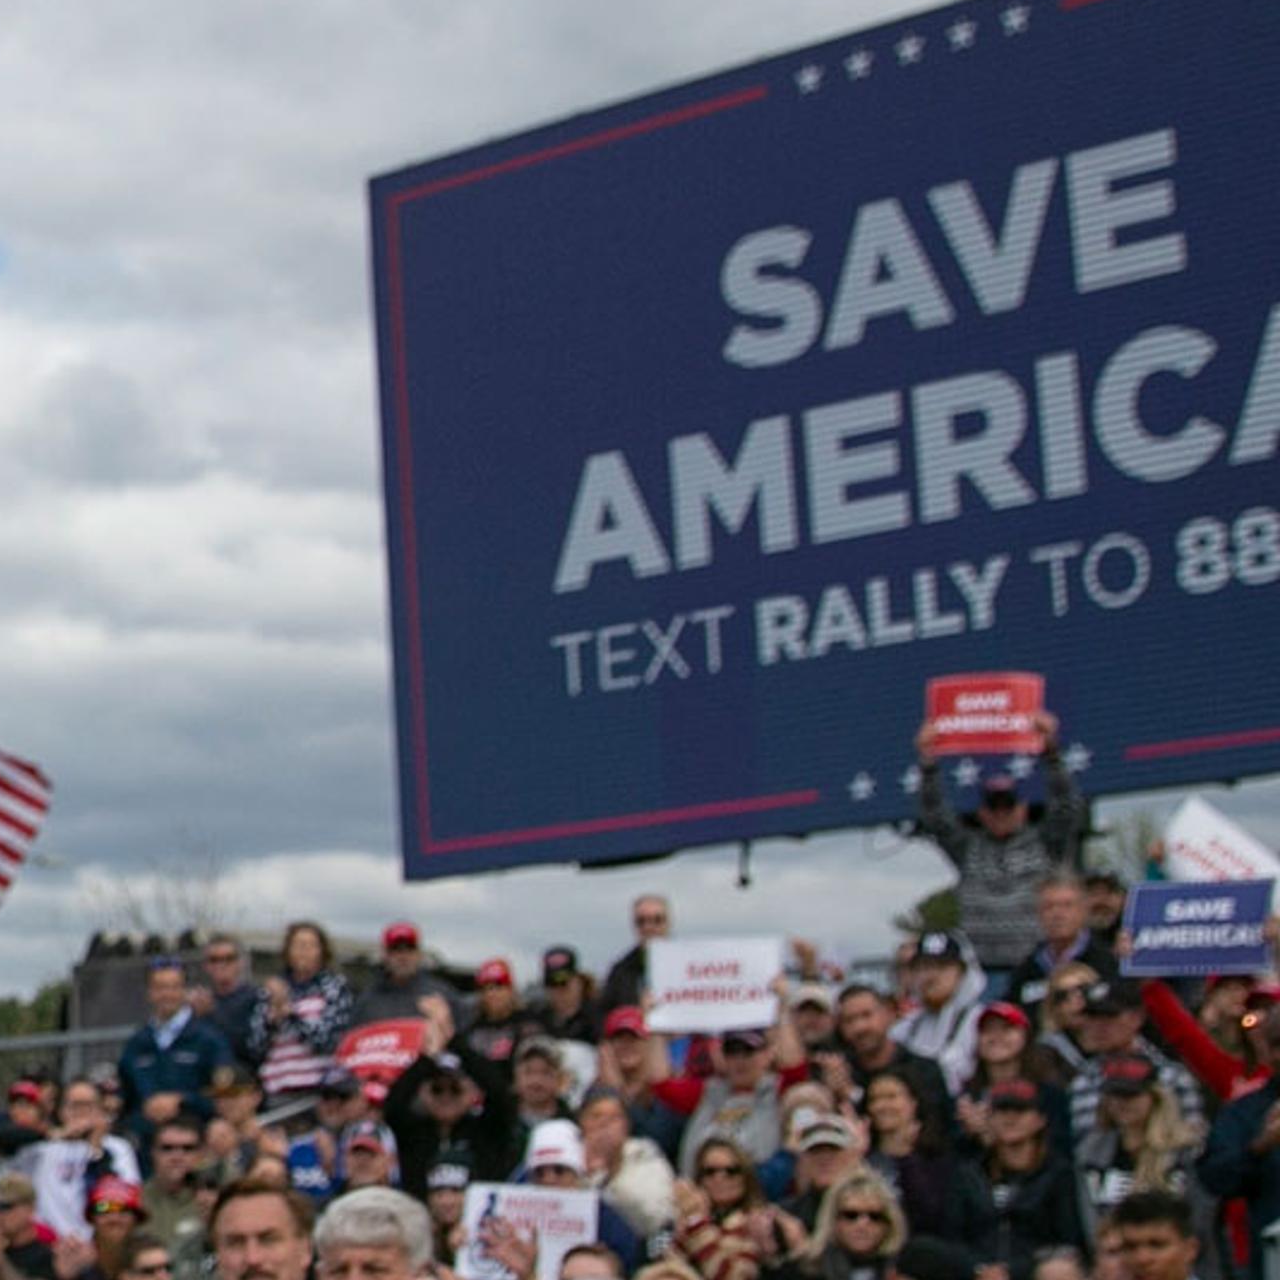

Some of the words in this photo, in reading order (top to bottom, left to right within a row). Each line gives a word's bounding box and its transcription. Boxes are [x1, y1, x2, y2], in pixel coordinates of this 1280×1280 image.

[719, 126, 1187, 369] SAVE
[552, 605, 735, 698] TEXT
[755, 556, 1010, 666] RALLY
[1031, 531, 1152, 617] TO
[1164, 897, 1236, 923] SAVE
